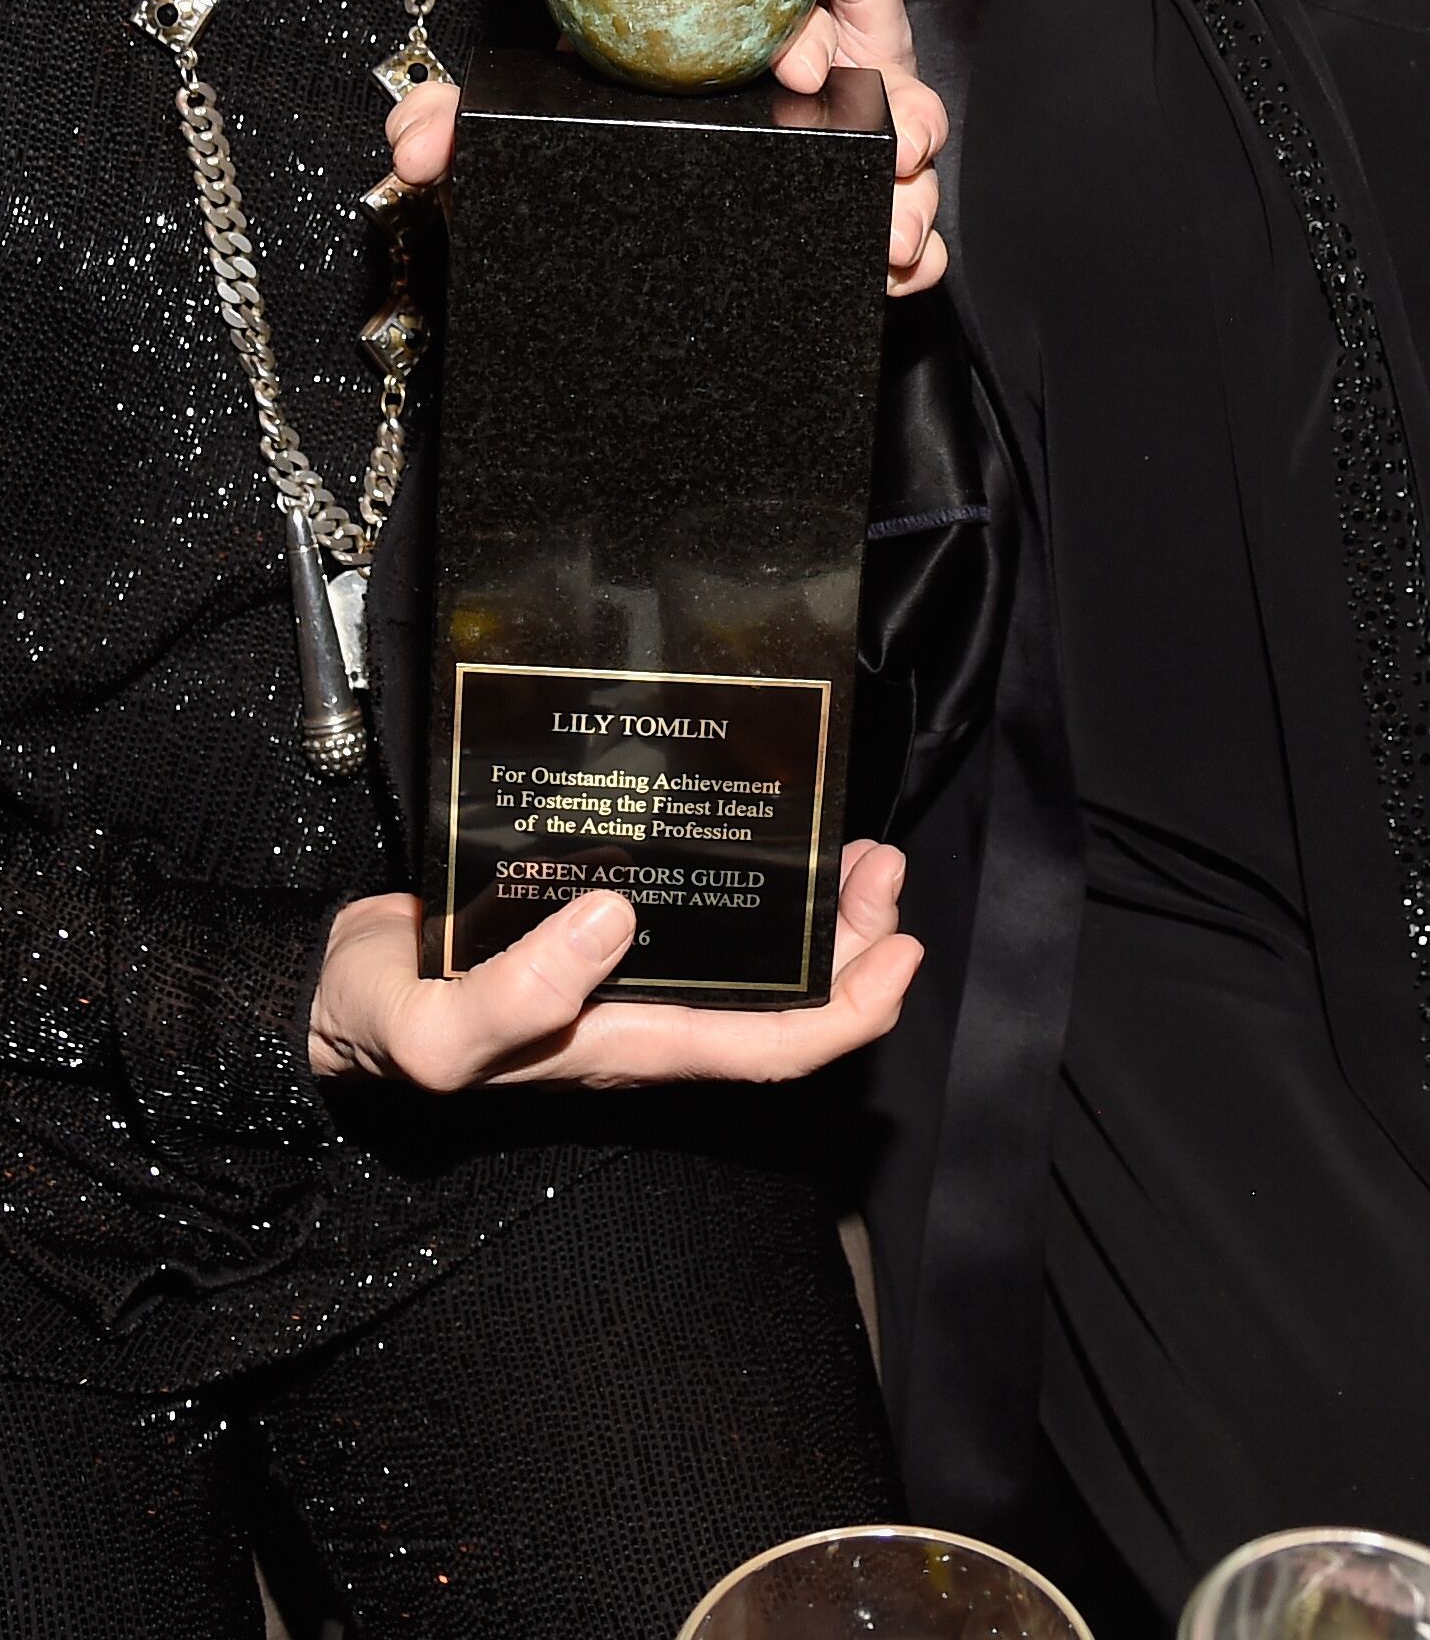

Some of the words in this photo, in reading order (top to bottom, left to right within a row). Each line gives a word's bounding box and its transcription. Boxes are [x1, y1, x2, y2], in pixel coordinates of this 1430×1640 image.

[552, 712, 616, 735] LILY
[619, 715, 728, 740] TOMLIN
[490, 765, 526, 783] For
[531, 767, 649, 792] Outstanding
[653, 773, 781, 795] Achievement
[496, 789, 514, 807] in
[520, 791, 612, 813] Fostering
[617, 795, 647, 813] the
[652, 797, 712, 816] Finest
[716, 799, 774, 818] Ideals
[514, 814, 539, 832] of
[546, 816, 576, 833] the
[580, 817, 646, 840] Acting
[651, 821, 752, 840] Profession
[495, 861, 587, 881] SCREEN
[591, 865, 685, 886] ACTORS
[691, 869, 765, 888] GUILD
[496, 884, 539, 900] LIFE
[689, 892, 761, 908] AWARD
